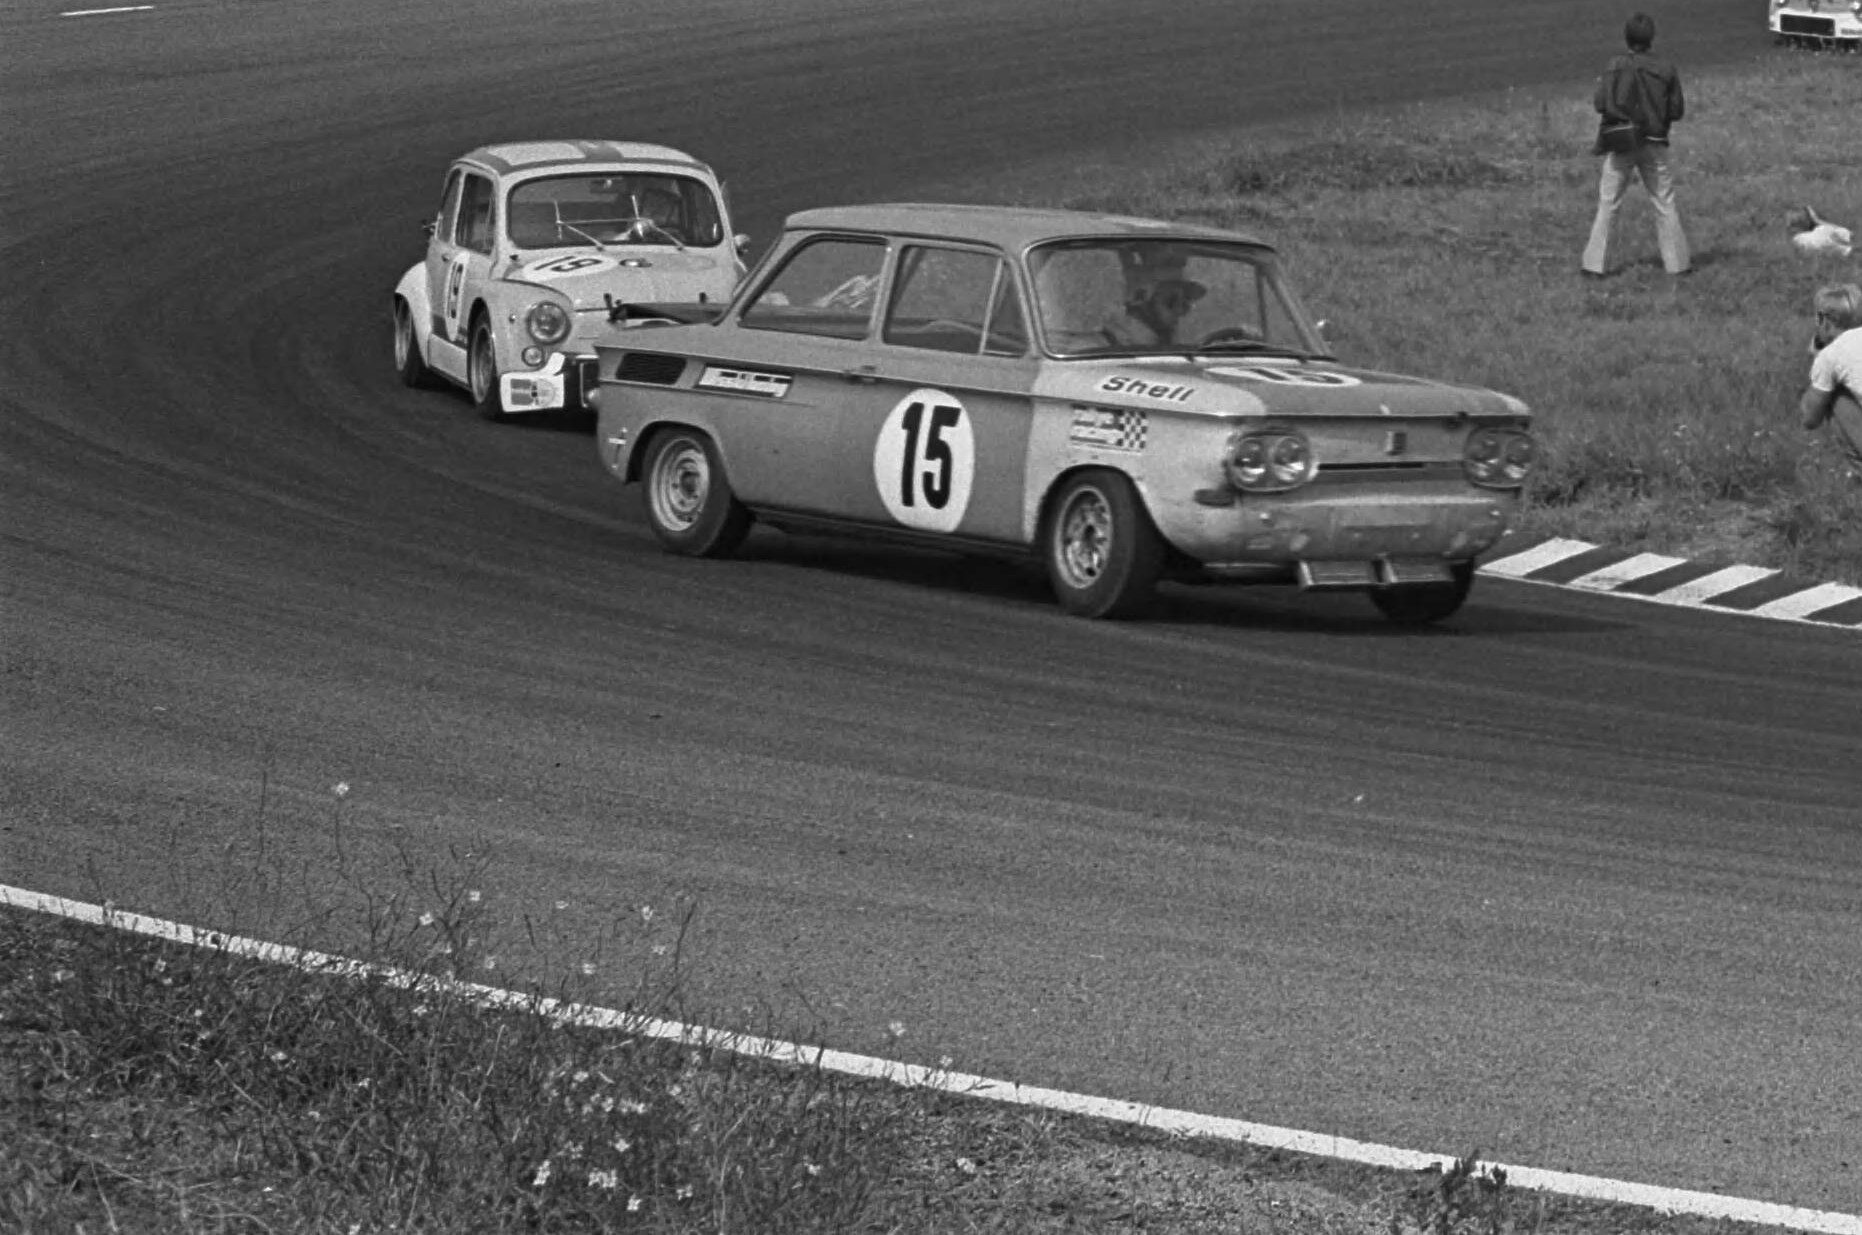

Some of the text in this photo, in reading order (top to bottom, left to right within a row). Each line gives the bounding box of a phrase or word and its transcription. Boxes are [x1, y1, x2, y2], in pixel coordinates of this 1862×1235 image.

[533, 255, 604, 272] 19
[446, 261, 465, 319] 19
[1101, 375, 1195, 402] Shell
[901, 401, 962, 510] 15
